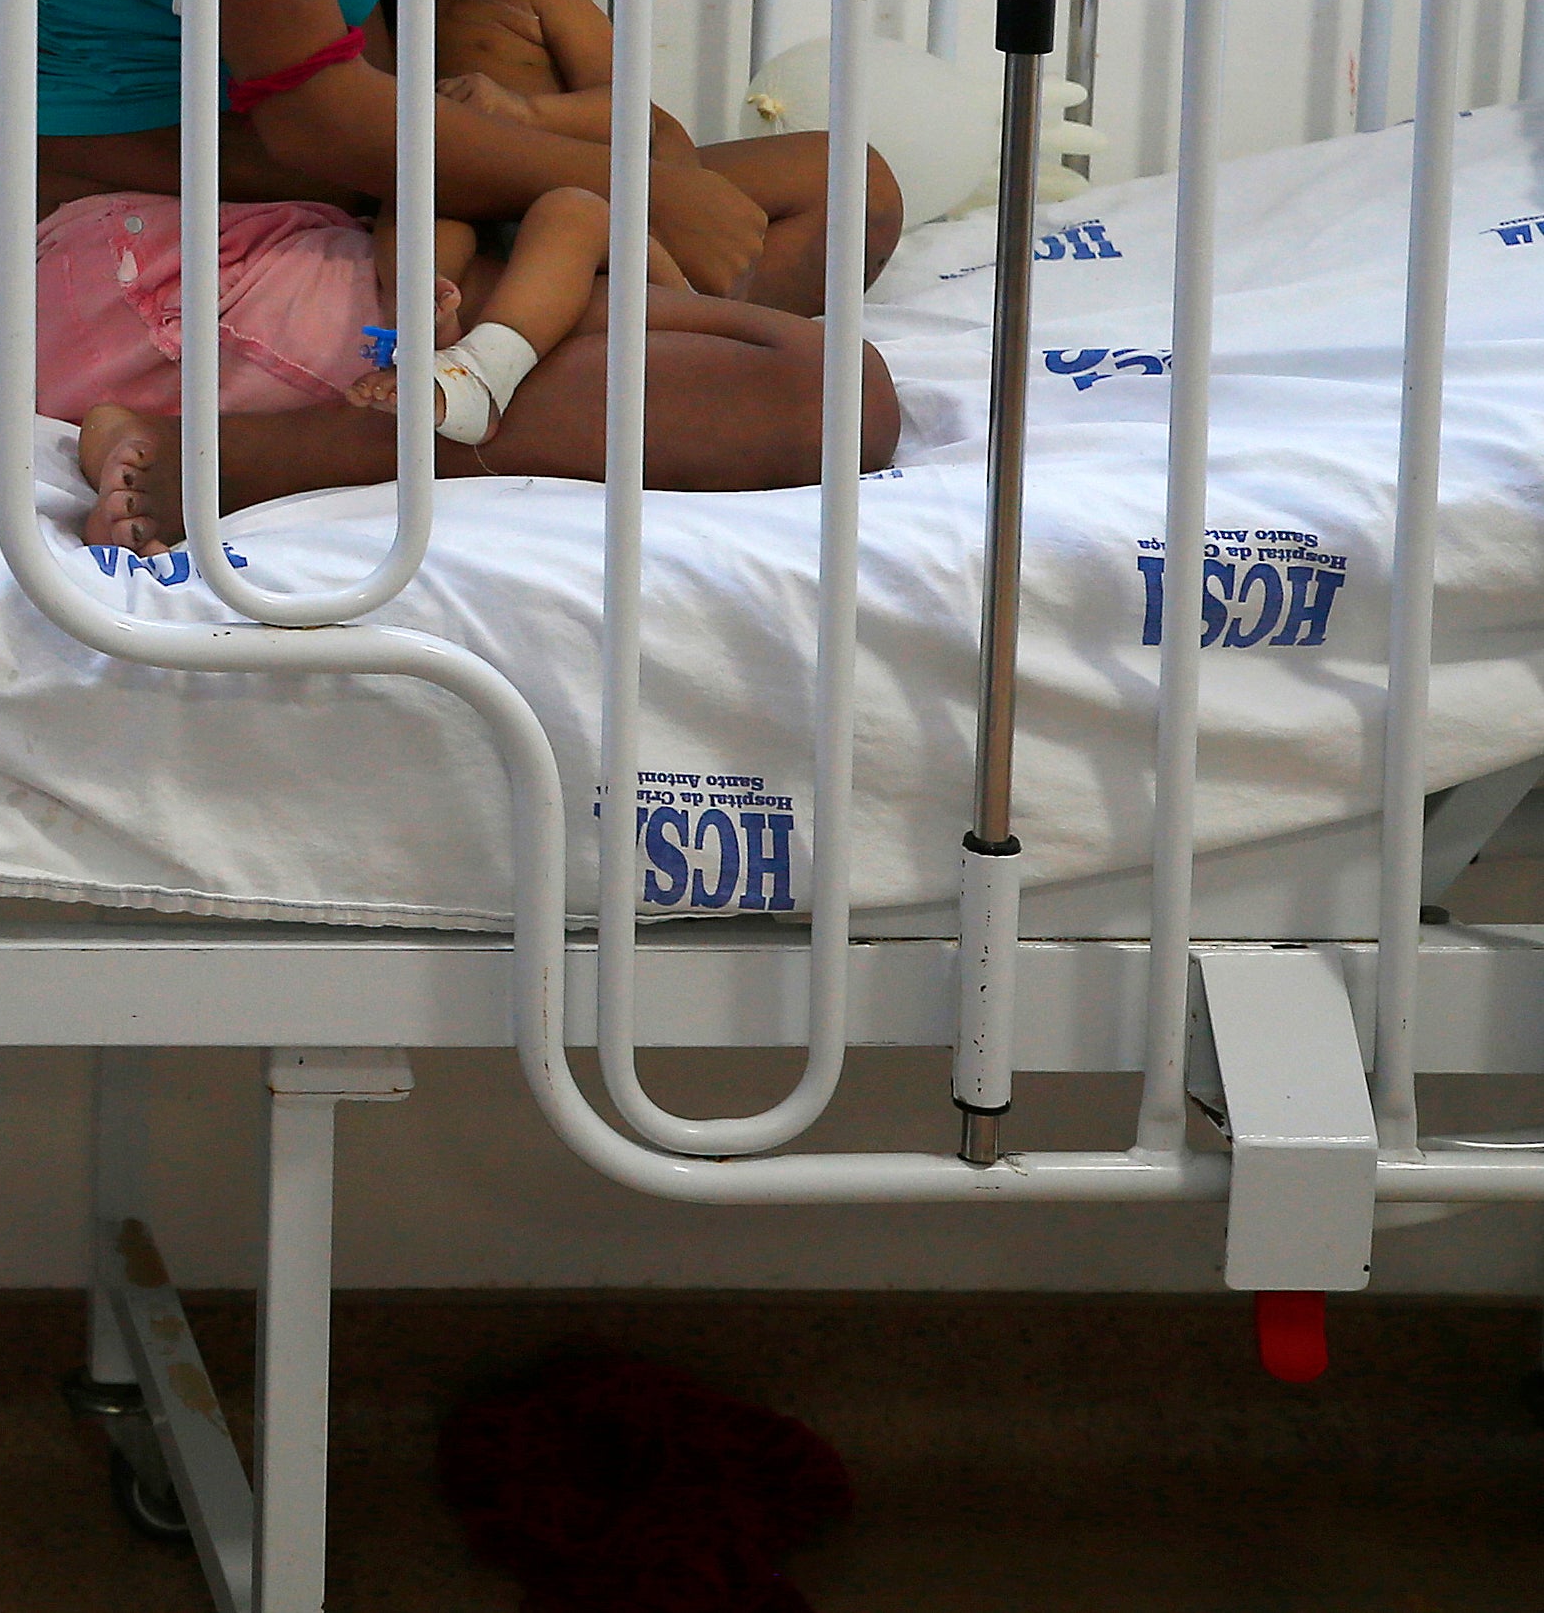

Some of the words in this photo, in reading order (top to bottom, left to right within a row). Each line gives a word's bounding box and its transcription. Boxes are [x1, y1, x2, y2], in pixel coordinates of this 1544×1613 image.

[1204, 529, 1249, 543] Anto
[1255, 529, 1319, 548] Santo
[1226, 546, 1252, 562] da
[1257, 547, 1348, 570] Hospital
[637, 771, 701, 788] Antoni
[706, 774, 765, 791] Santo
[680, 791, 704, 803] da
[709, 792, 794, 811] Hospital
